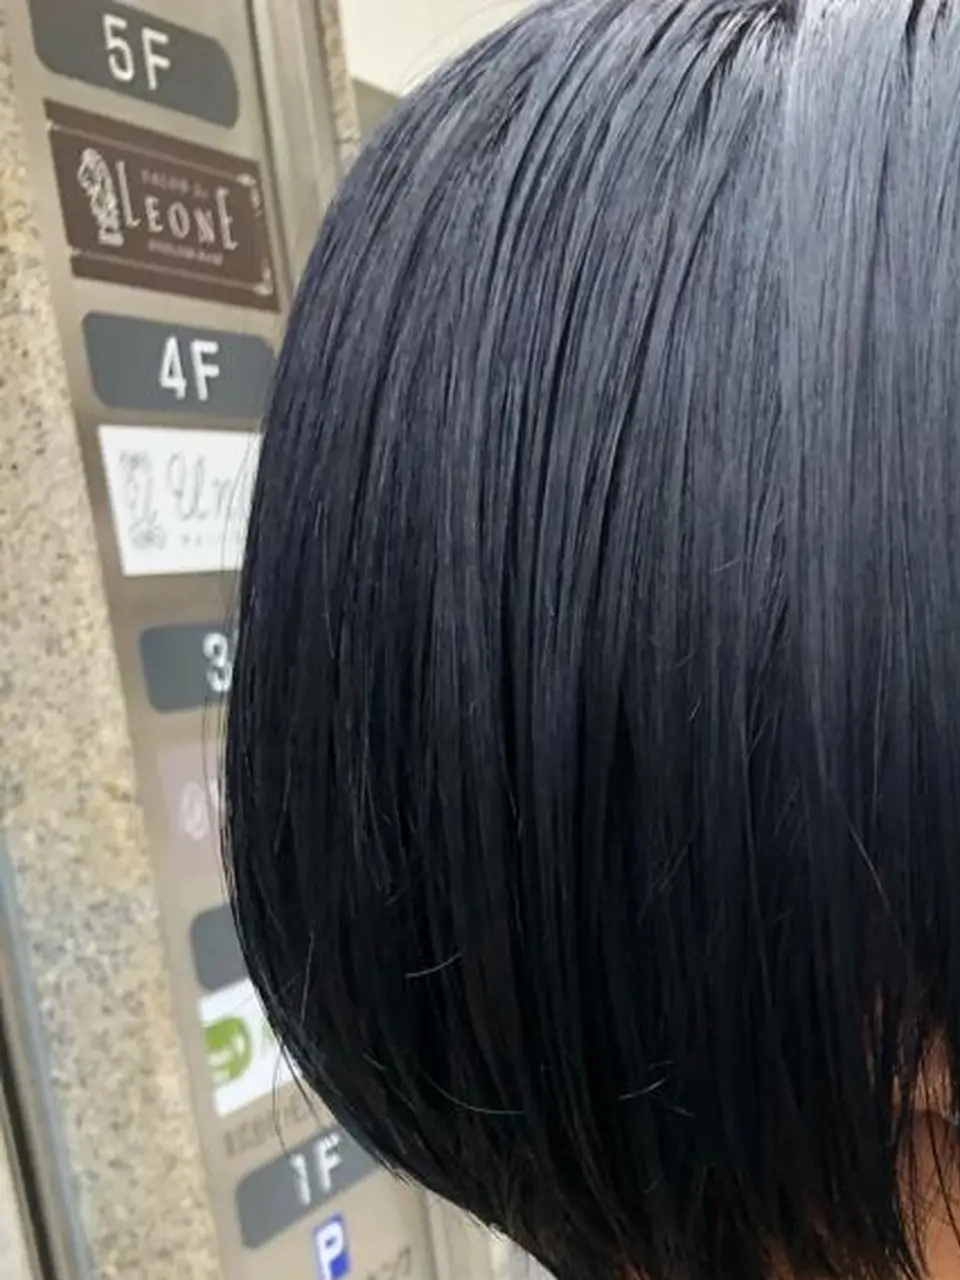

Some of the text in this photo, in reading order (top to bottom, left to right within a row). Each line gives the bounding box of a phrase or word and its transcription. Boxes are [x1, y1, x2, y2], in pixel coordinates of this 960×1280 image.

[103, 12, 171, 91] 5F
[115, 160, 239, 250] LEONE
[159, 335, 220, 401] 4F
[290, 1132, 342, 1206] 1F
